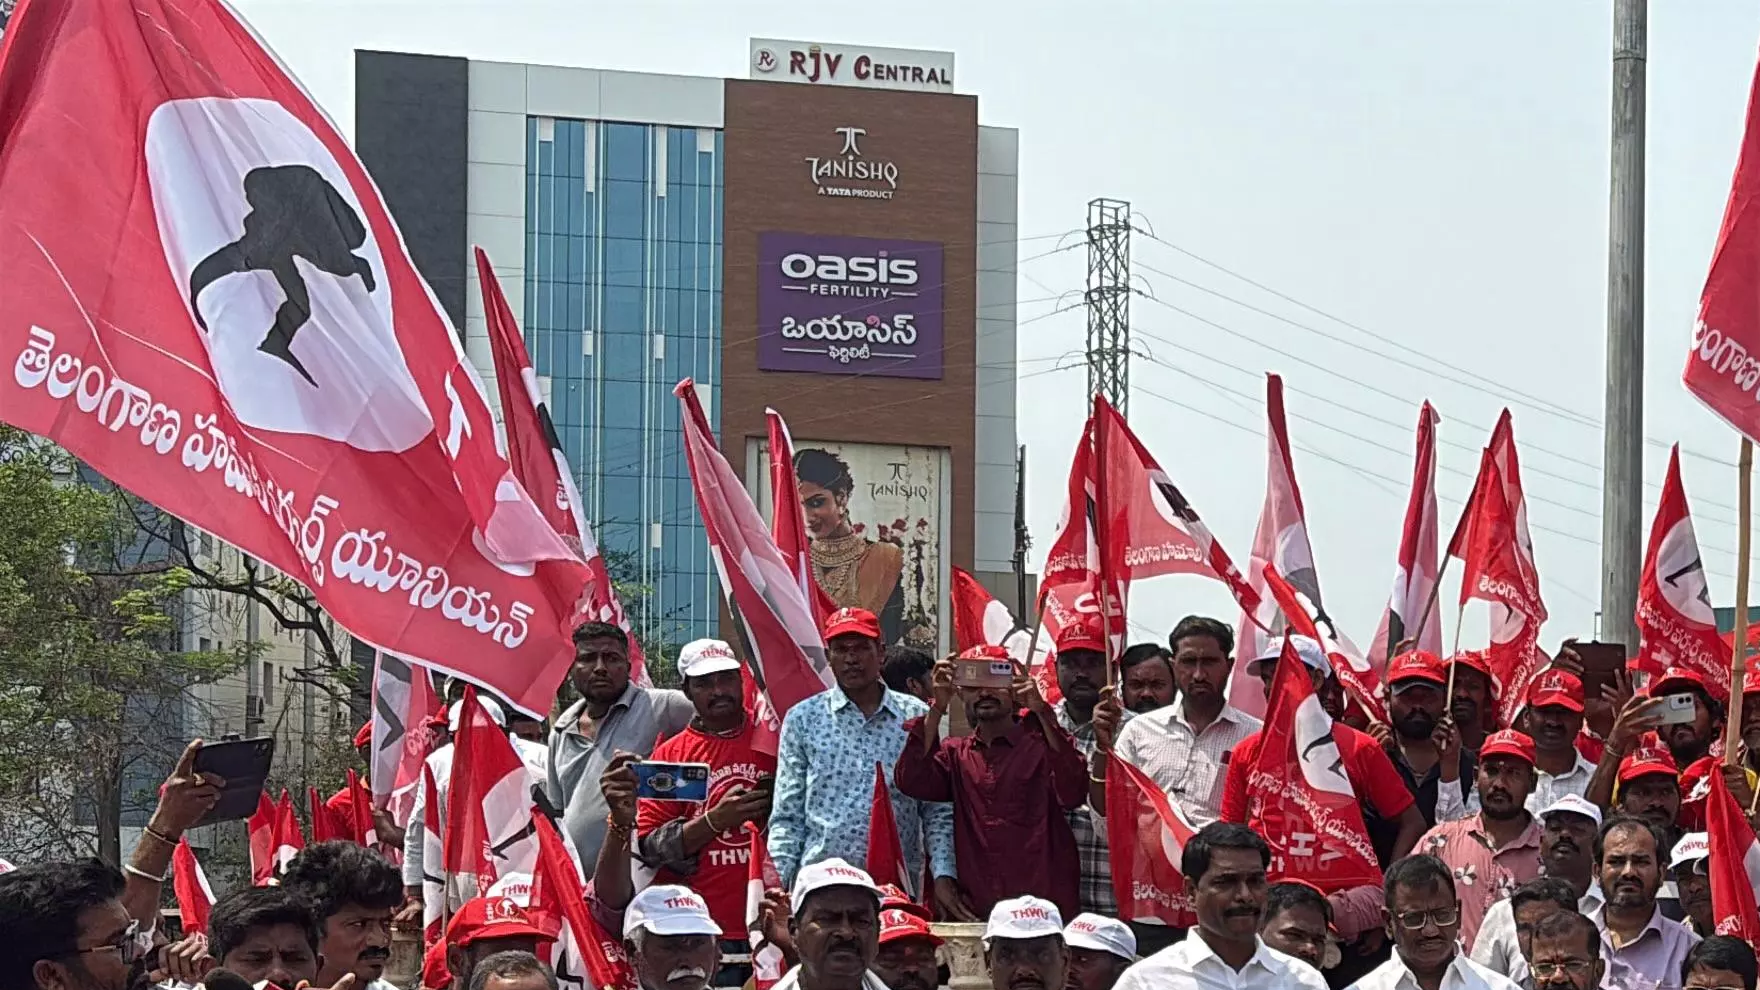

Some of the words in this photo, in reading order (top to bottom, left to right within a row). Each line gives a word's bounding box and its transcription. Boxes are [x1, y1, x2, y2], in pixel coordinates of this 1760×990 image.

[789, 45, 842, 83] RJV
[818, 187, 825, 195] A
[827, 187, 851, 197] TATA
[852, 189, 894, 200] PRODUCT
[781, 250, 918, 285] oasis
[810, 283, 890, 298] FERTILITY
[14, 324, 181, 455] తెలంగాణ
[708, 848, 752, 867] THW
[1011, 907, 1049, 920] THWU
